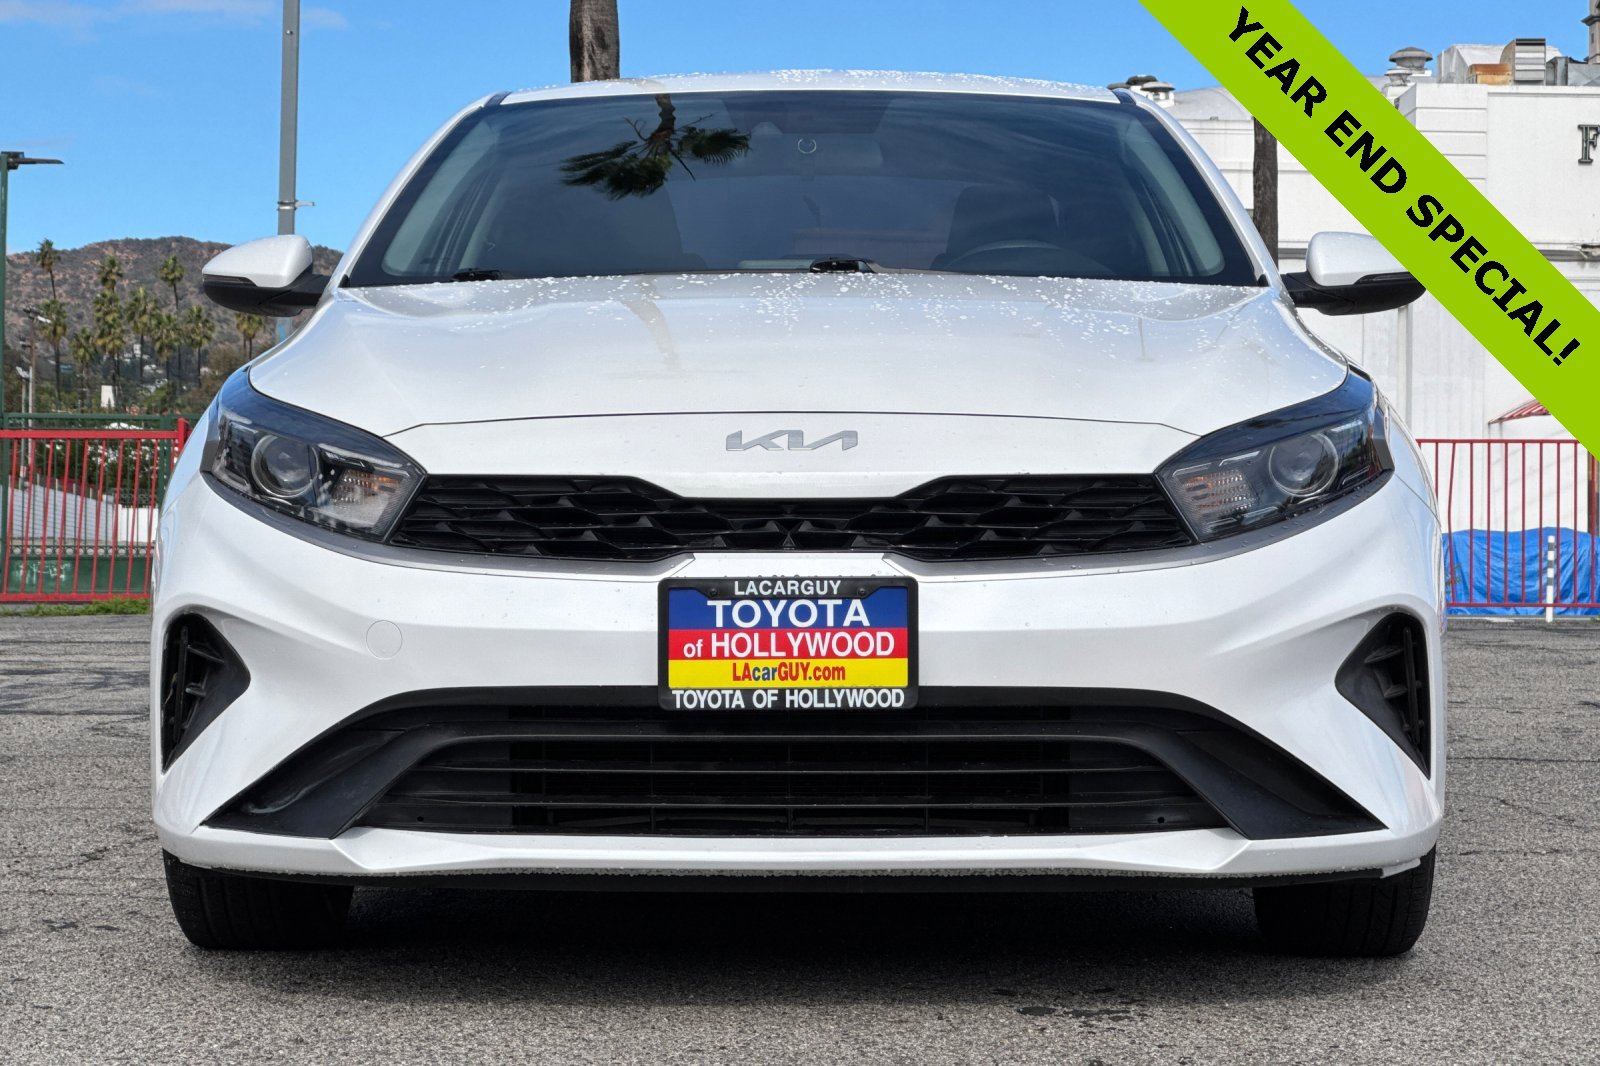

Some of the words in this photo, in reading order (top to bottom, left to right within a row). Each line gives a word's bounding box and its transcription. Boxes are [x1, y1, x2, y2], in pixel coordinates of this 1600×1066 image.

[734, 580, 841, 595] LACARGUY
[707, 599, 870, 628] TOYOTA
[683, 639, 703, 658] of
[711, 631, 895, 657] HOLLYWOOD
[732, 662, 846, 682] LAcarGUY.com
[672, 690, 745, 709] TOYOTA
[752, 690, 778, 708] OF
[785, 689, 905, 708] HOLLYWOOD
